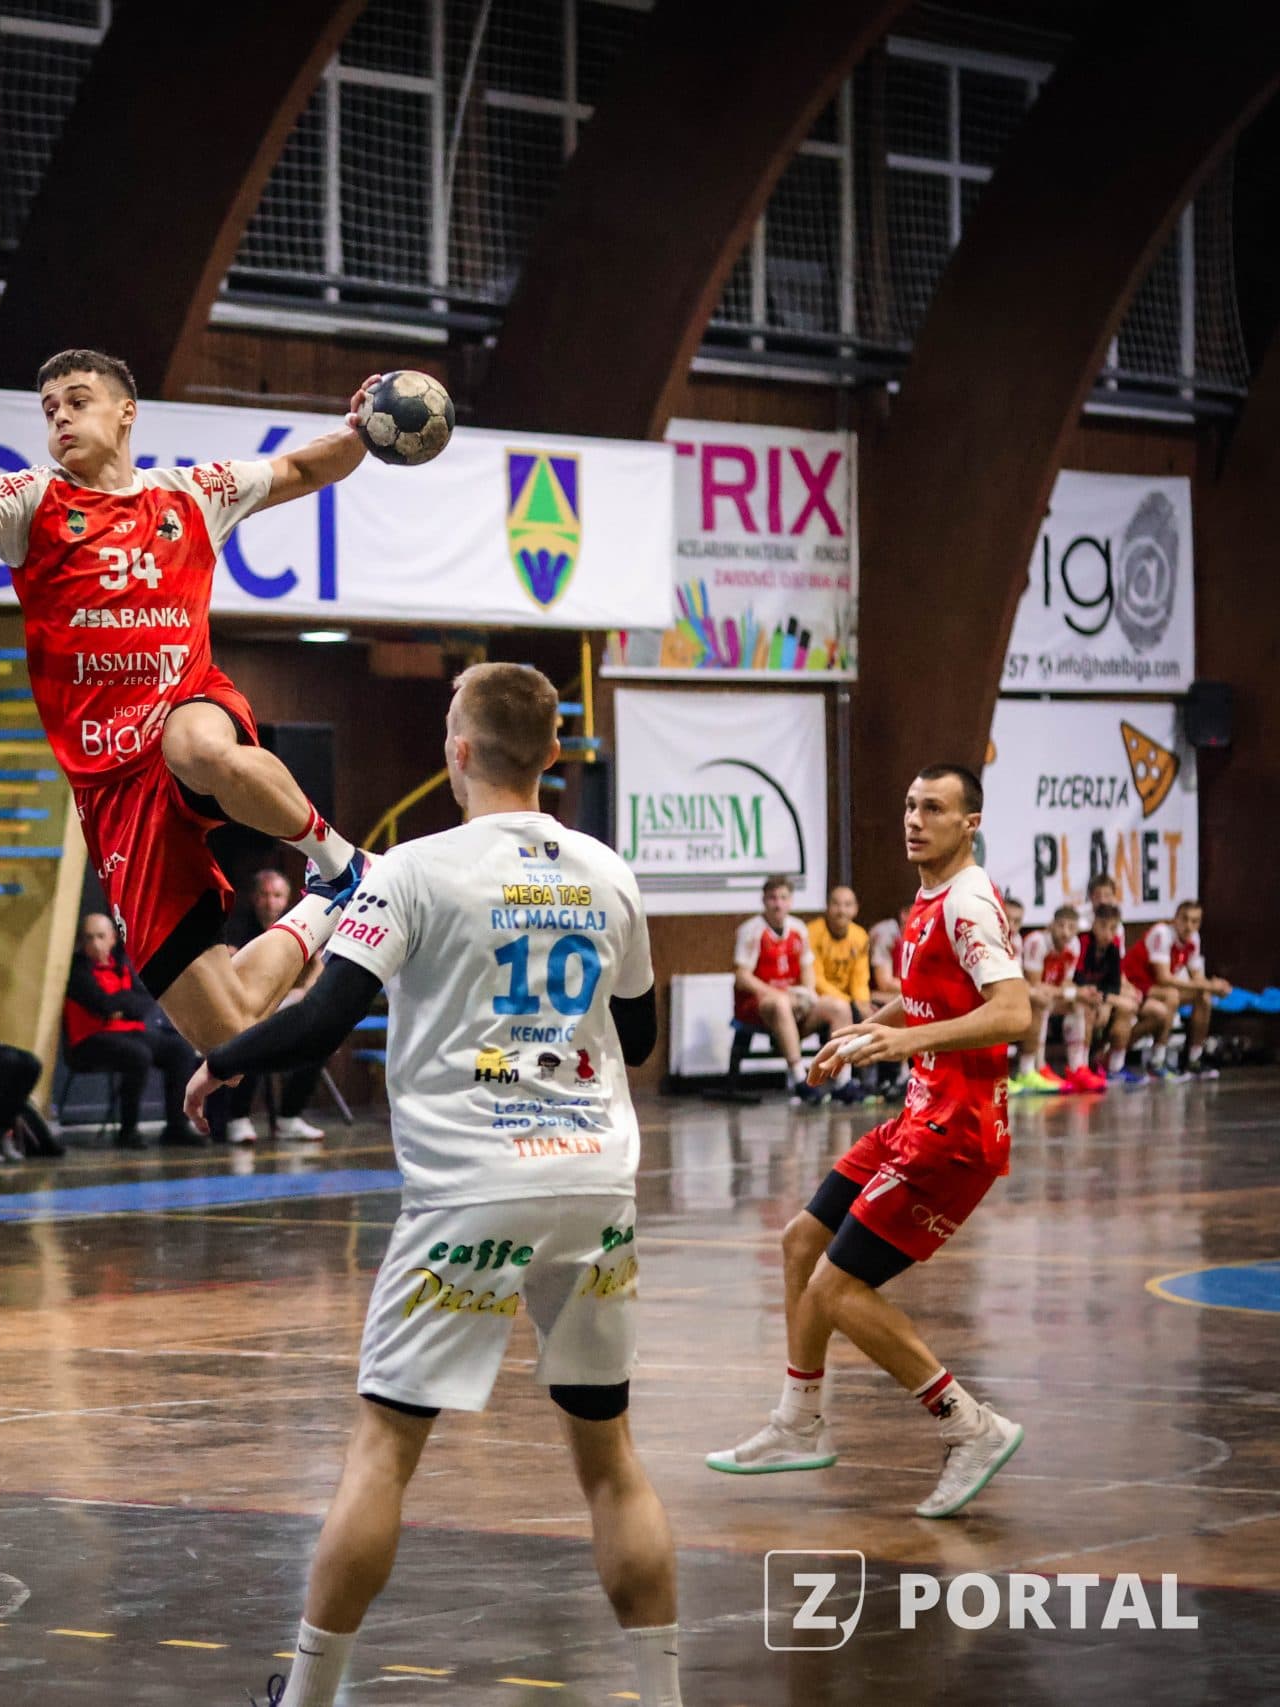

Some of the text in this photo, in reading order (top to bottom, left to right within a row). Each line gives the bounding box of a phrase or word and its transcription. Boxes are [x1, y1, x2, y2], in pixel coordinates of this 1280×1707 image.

[99, 547, 162, 590] 34
[1035, 775, 1130, 809] PICERIJA
[502, 885, 592, 906] MEGA TAS
[491, 909, 607, 931] RK MAGLAJ
[492, 934, 602, 1016] 10
[513, 1136, 601, 1158] TIMKEN
[428, 1239, 534, 1271] caffe
